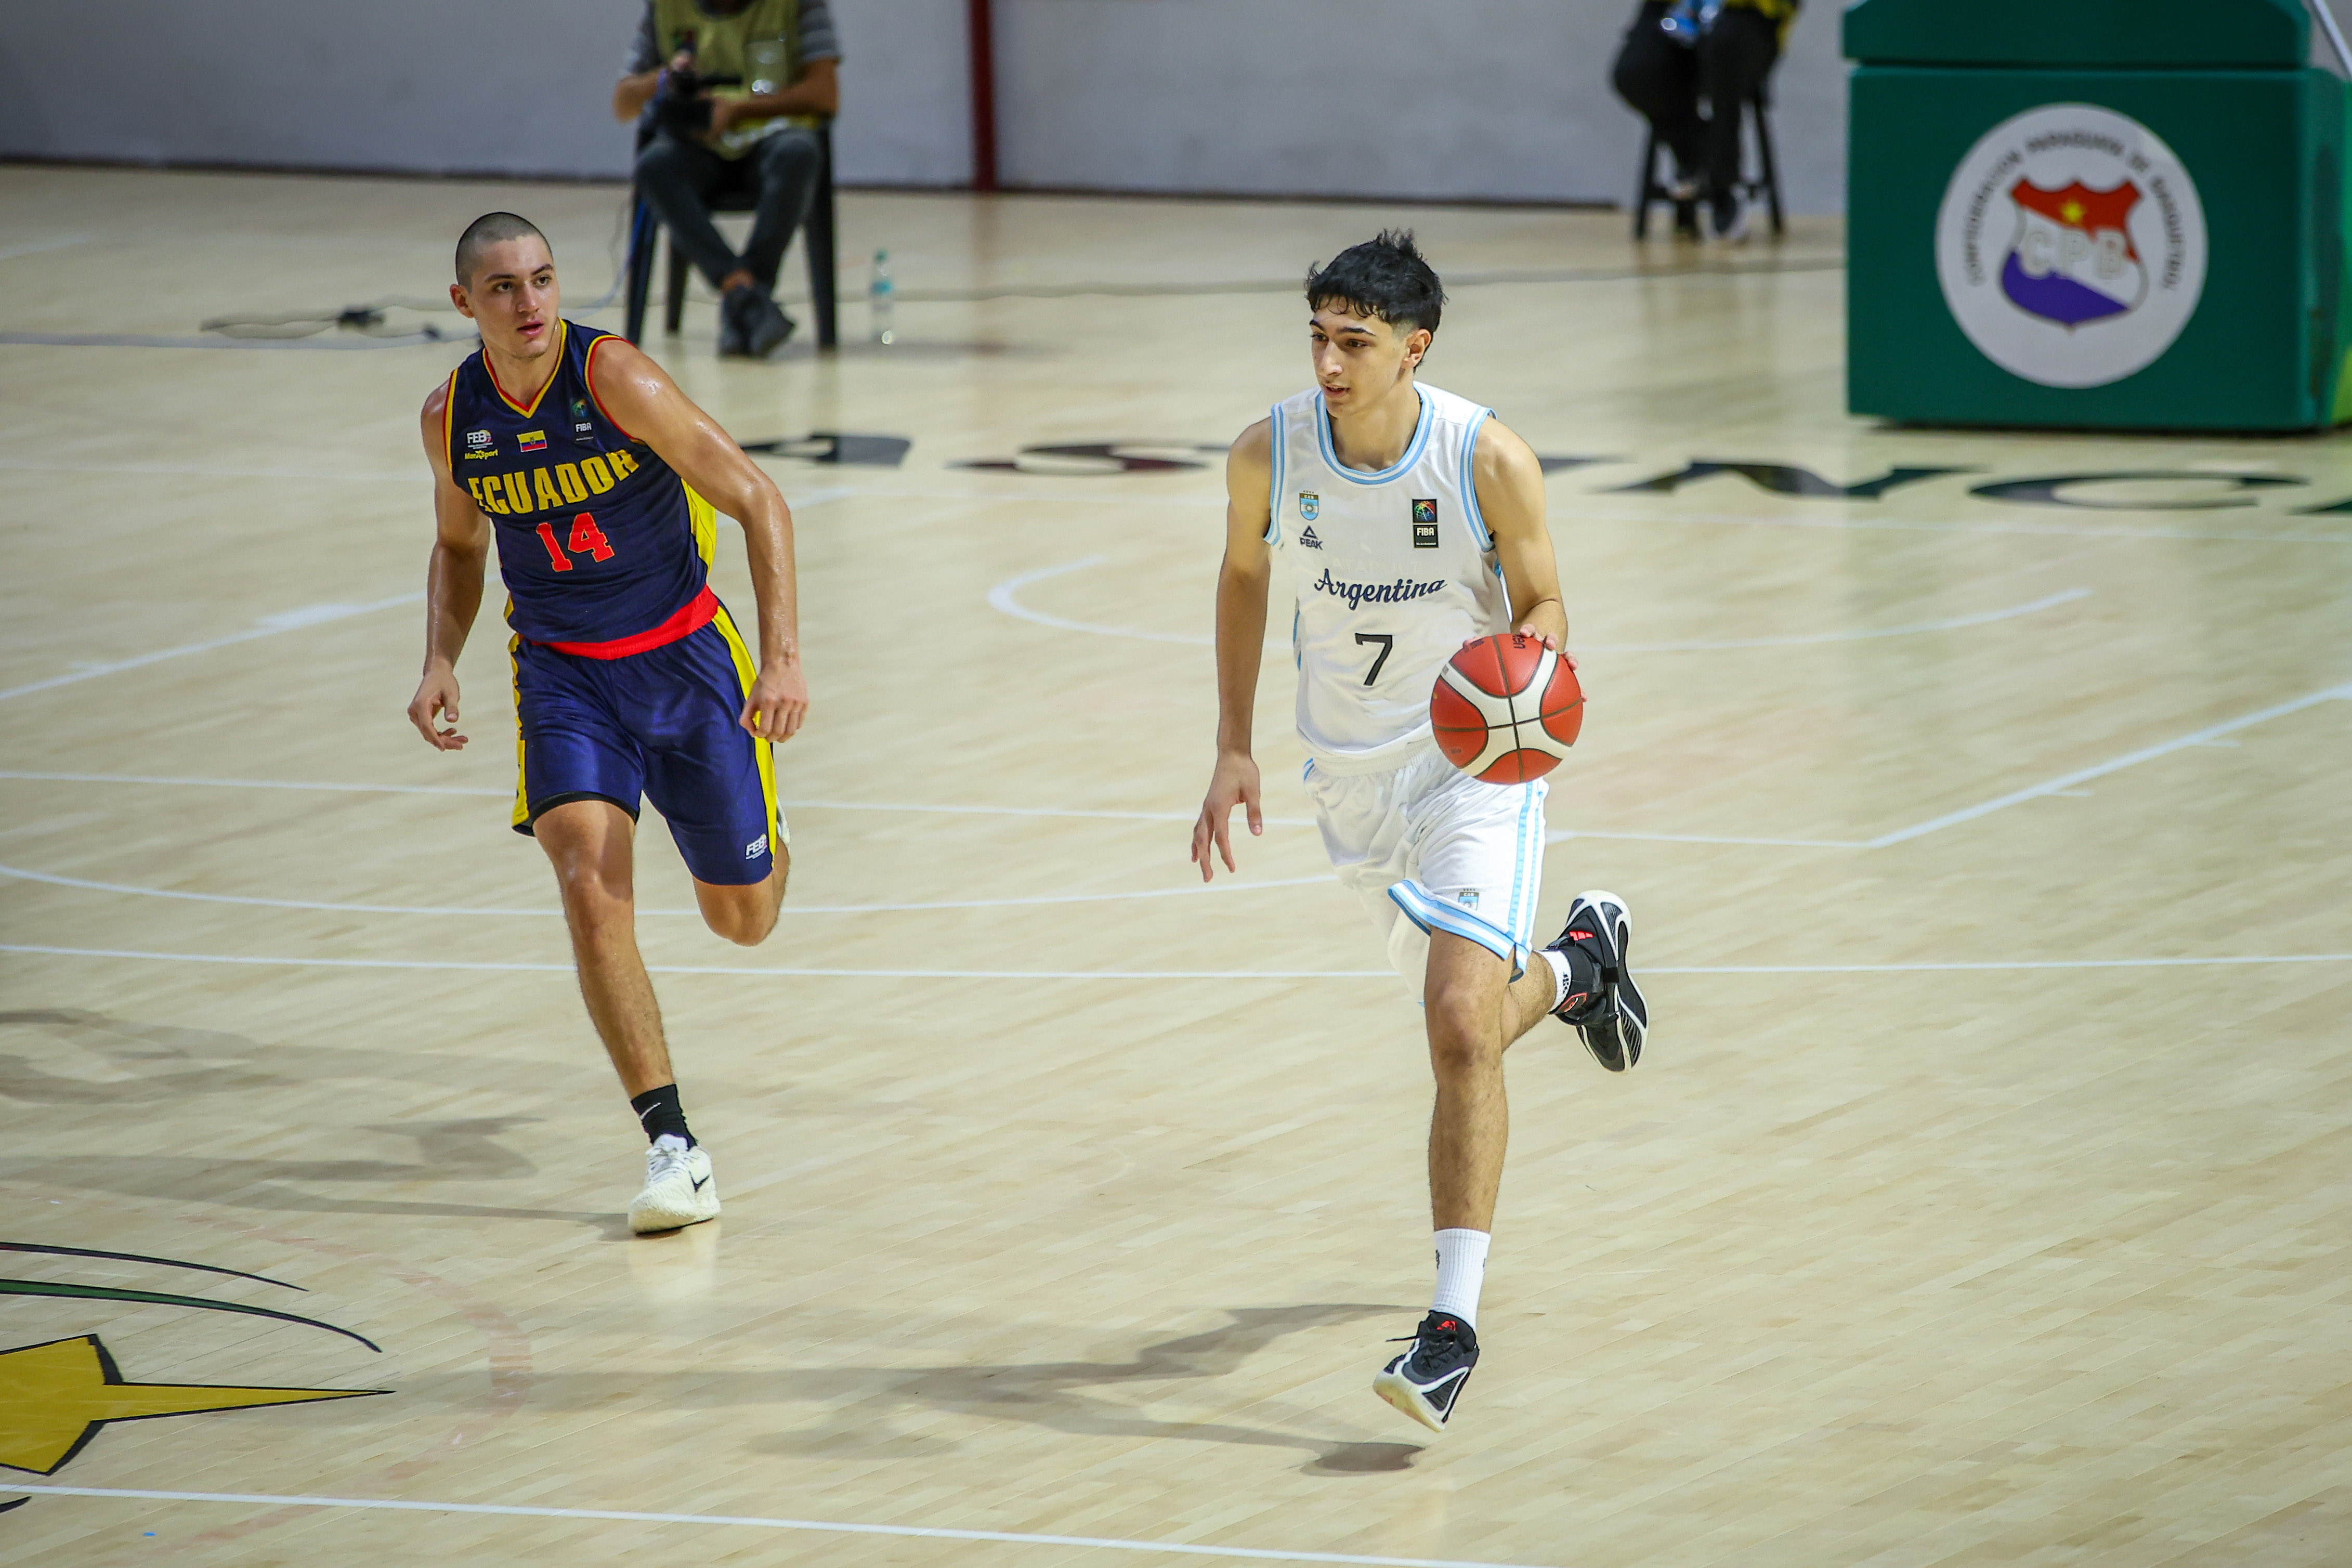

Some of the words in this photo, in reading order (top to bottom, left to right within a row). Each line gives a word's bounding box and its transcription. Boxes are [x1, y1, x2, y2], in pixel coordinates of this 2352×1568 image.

[576, 423, 592, 433] FIBA
[467, 432, 487, 444] FEB
[468, 449, 640, 515] ECUADOR
[1416, 527, 1435, 537] FIBA
[535, 512, 615, 572] 14
[1299, 537, 1323, 551] PEAK
[1314, 568, 1448, 610] Argentina
[1354, 632, 1393, 686] 7
[746, 837, 765, 856] FEB
